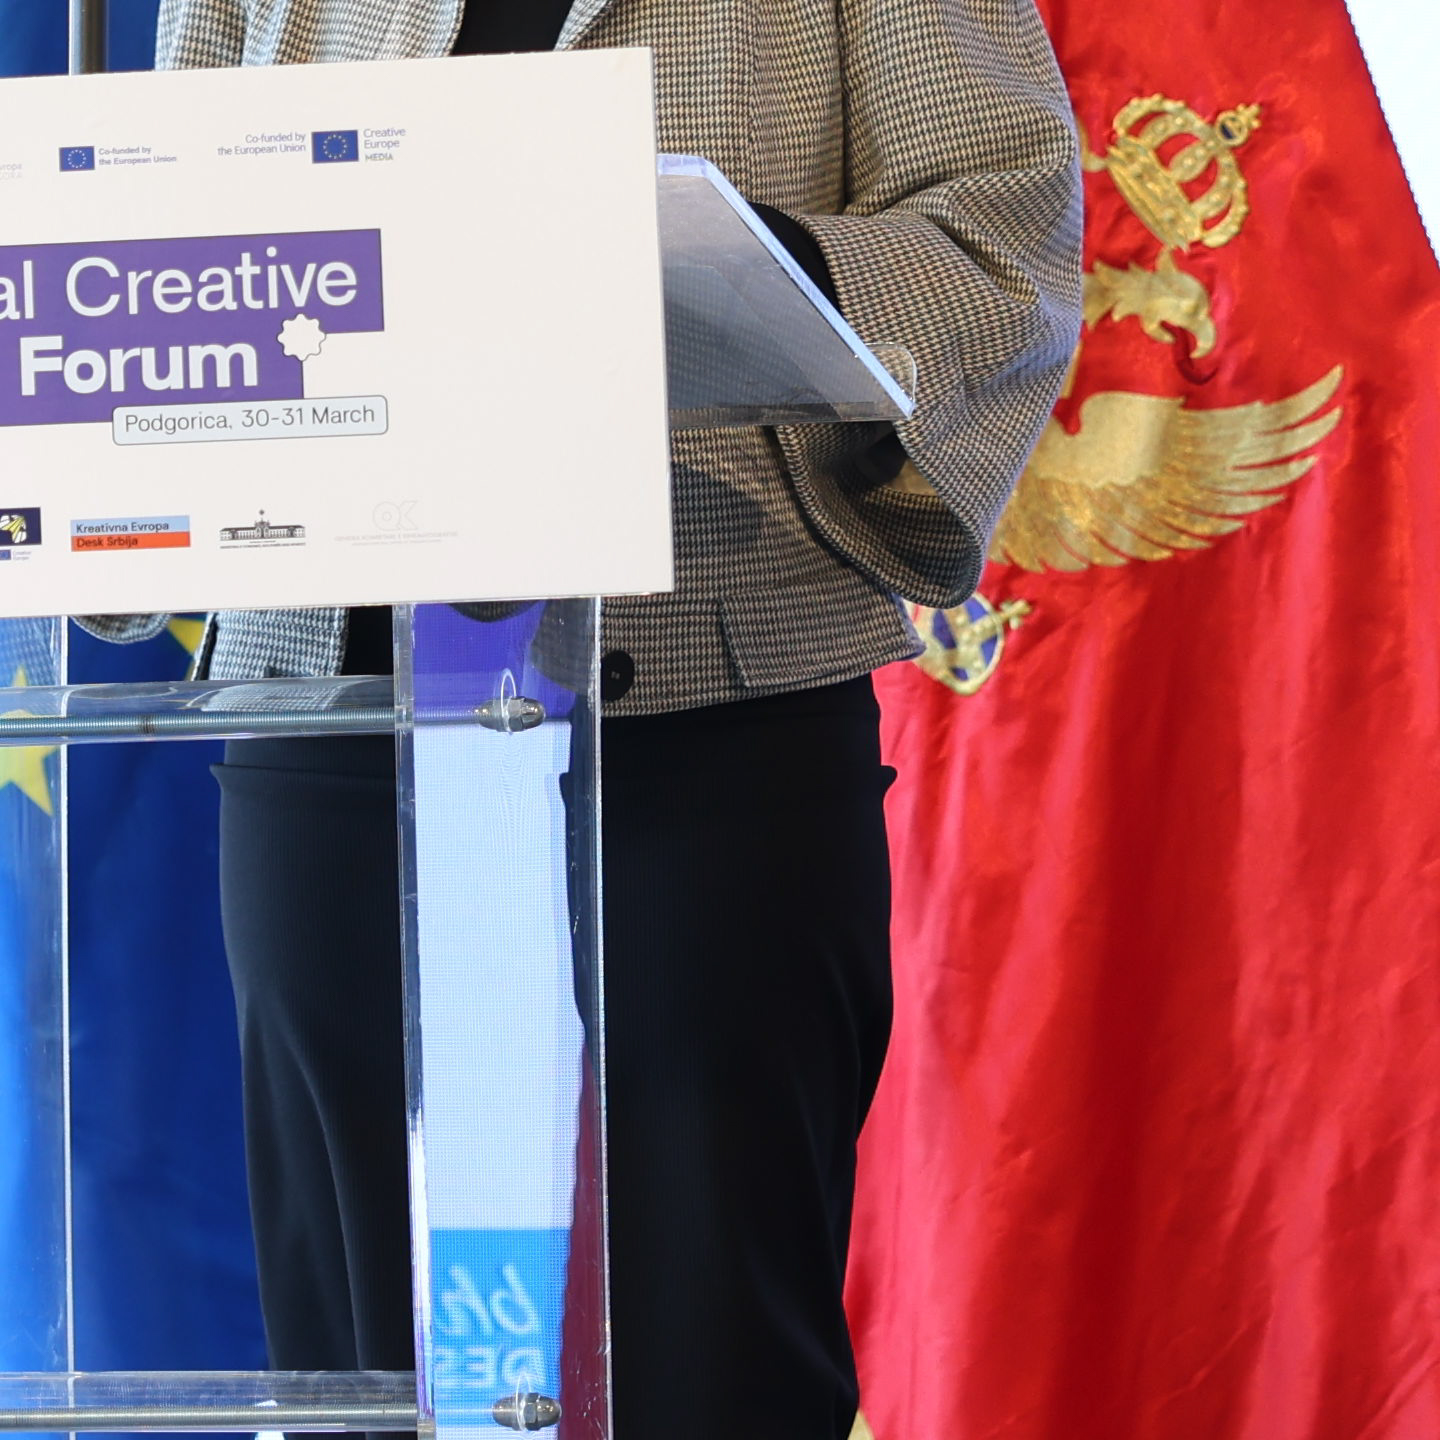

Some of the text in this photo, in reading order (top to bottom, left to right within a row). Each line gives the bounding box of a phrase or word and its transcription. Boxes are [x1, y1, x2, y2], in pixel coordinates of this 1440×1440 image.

[363, 127, 406, 138] Creative
[245, 133, 306, 144] Co-funded by
[217, 144, 306, 156] the European Union
[364, 139, 400, 150] Europe
[99, 146, 151, 156] Co-funded by
[99, 155, 177, 166] the European Union
[365, 153, 393, 162] MEDIA
[66, 246, 358, 317] Creative
[19, 335, 258, 397] Forum
[125, 404, 375, 436] Podgorica, 30-31 March
[76, 522, 170, 534] Kreativna Evropa
[76, 536, 139, 549] Desk Srbija
